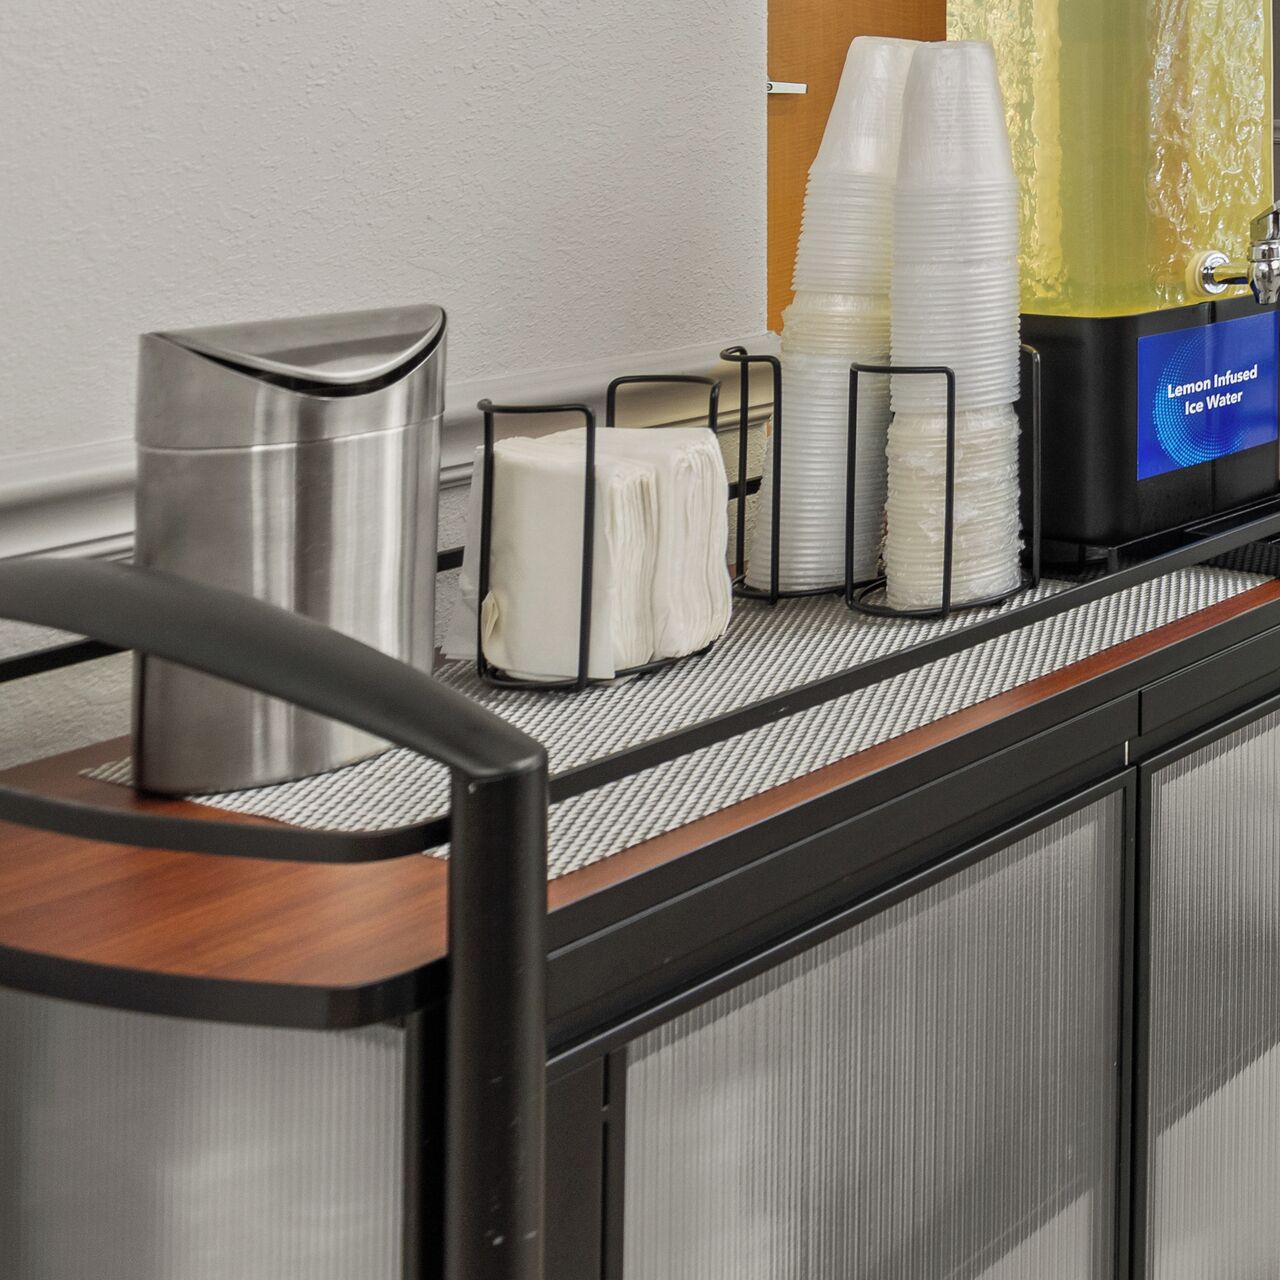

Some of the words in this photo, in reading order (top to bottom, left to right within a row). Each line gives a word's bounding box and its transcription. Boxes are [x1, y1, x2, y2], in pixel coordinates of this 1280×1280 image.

[1167, 377, 1211, 399] Lemon
[1214, 363, 1258, 388] Infused
[1185, 400, 1204, 415] Ice
[1206, 390, 1244, 410] Water
